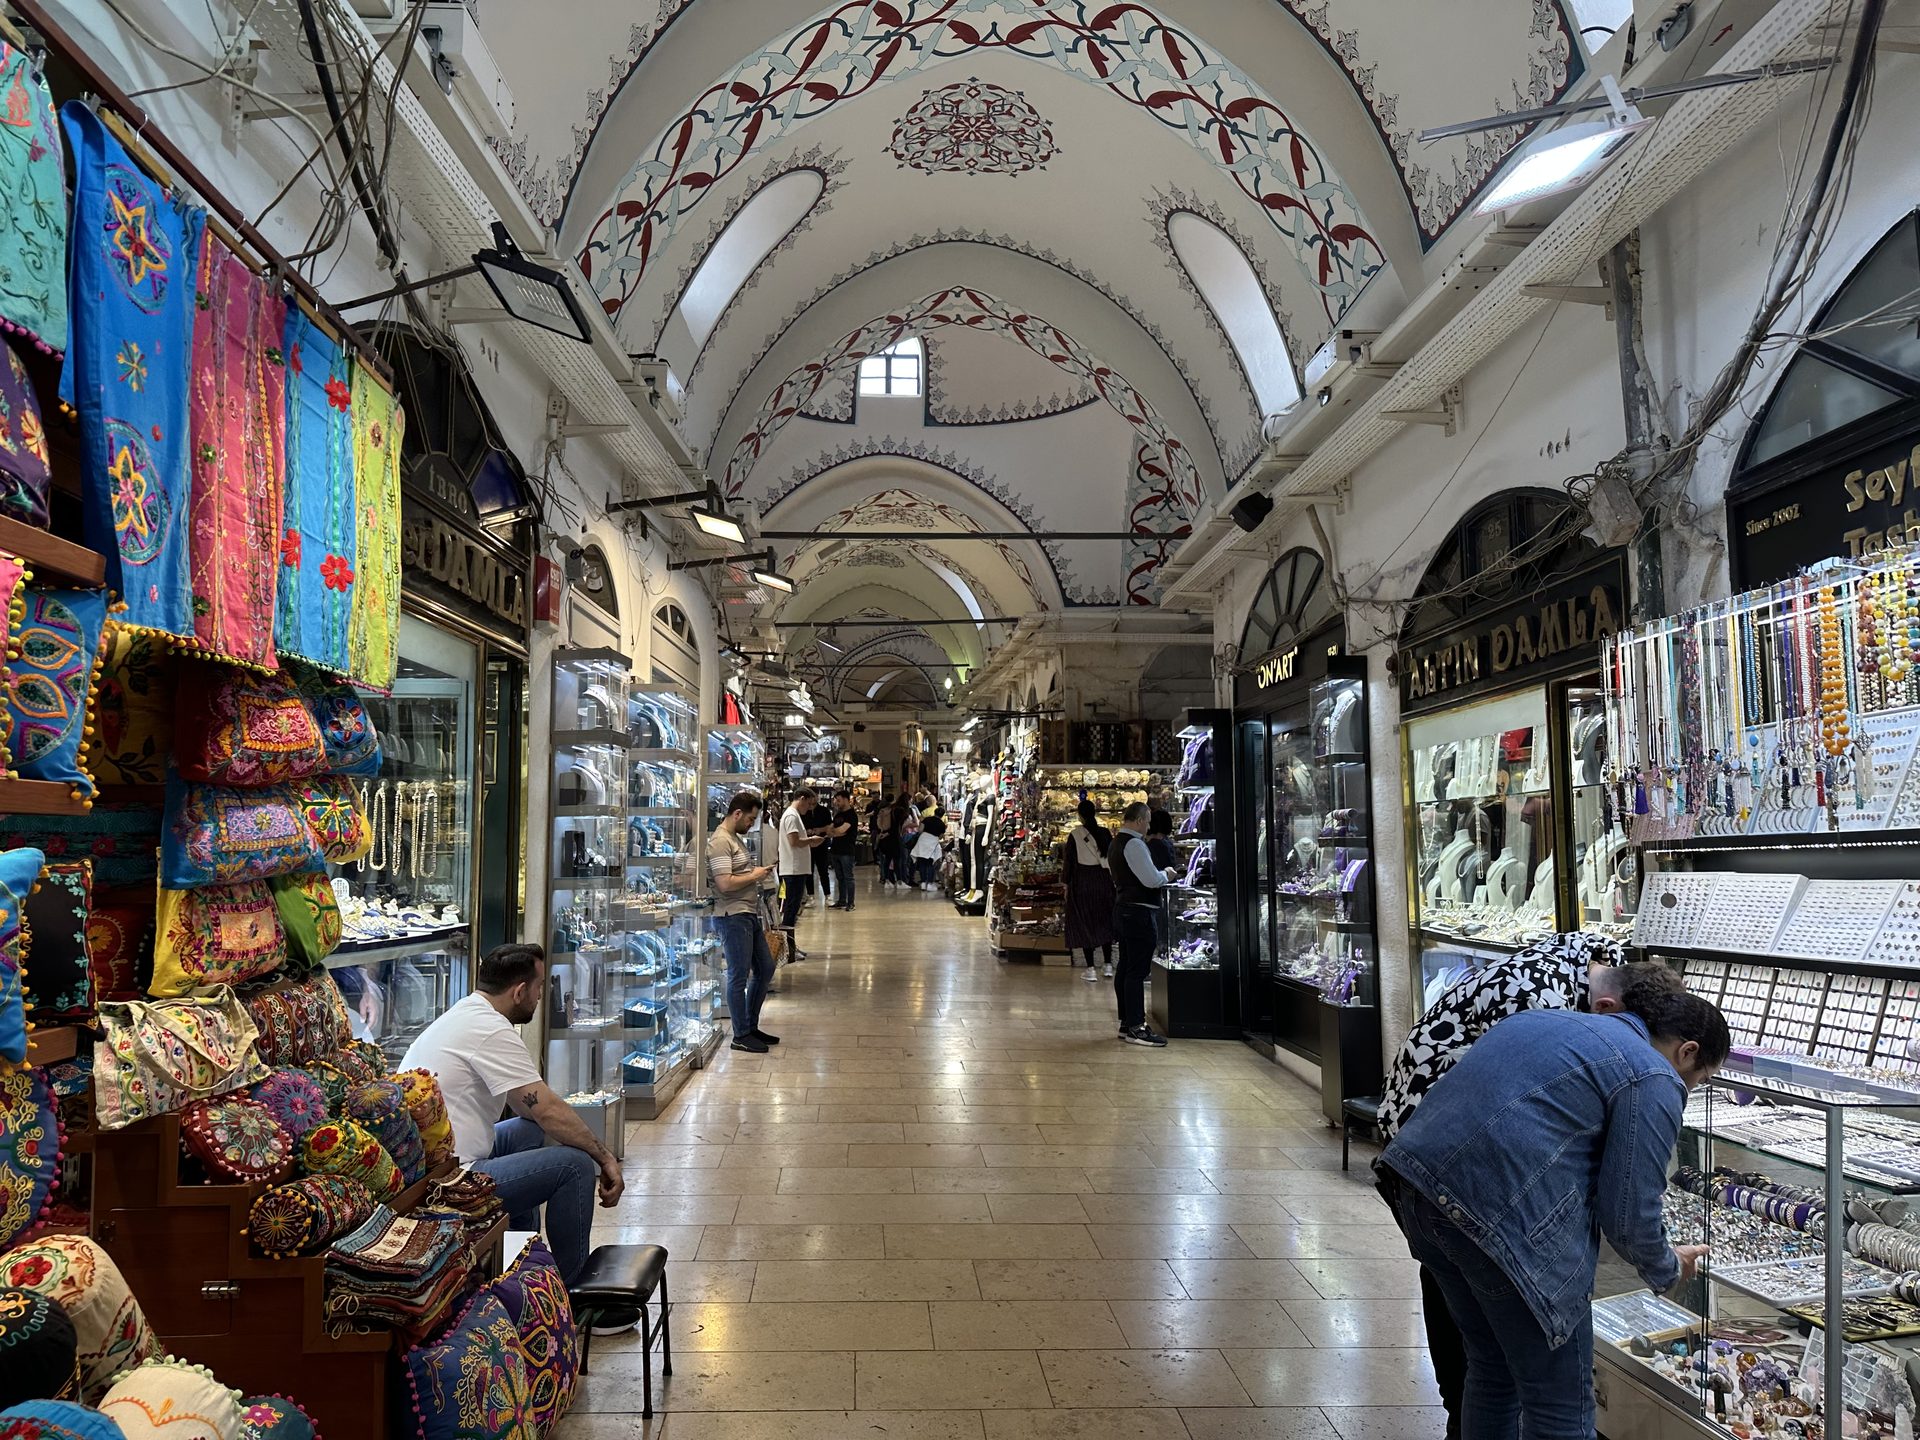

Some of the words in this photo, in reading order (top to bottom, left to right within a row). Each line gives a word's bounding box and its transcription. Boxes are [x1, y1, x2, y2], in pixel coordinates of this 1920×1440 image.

[431, 517, 527, 626] DAMLA
[1745, 516, 1772, 537] Since
[1772, 503, 1804, 526] 2002
[1408, 634, 1480, 700] ALTIN
[1491, 584, 1618, 672] DAMLA
